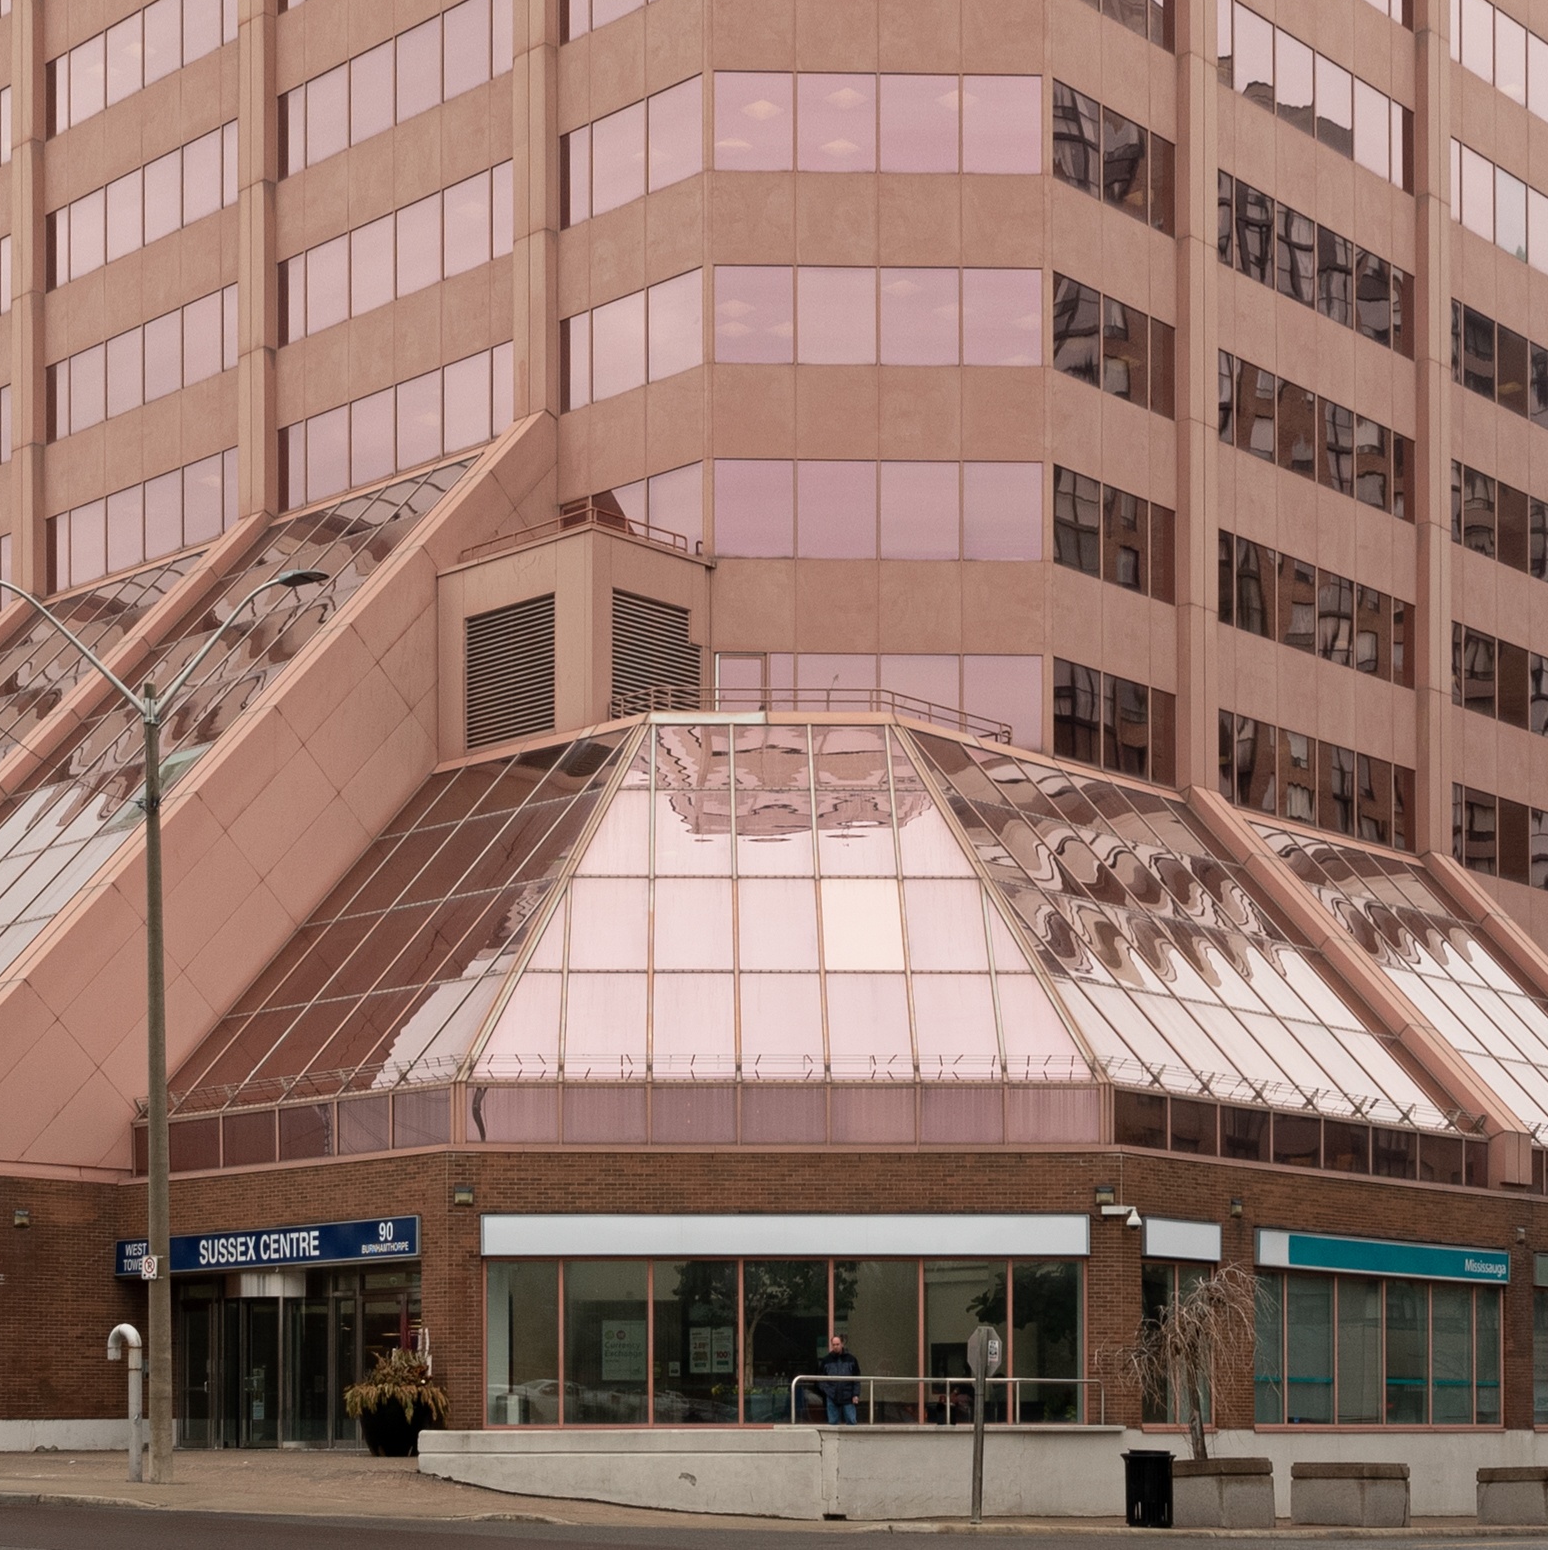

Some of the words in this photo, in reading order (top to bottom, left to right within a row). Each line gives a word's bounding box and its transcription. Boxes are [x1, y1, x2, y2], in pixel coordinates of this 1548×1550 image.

[378, 1221, 394, 1241] 90
[125, 1242, 147, 1256] WEST
[199, 1235, 256, 1265] SUSSEX
[260, 1230, 320, 1260] CENTRE
[361, 1241, 409, 1254] BURNHAMTHORPE
[123, 1258, 142, 1271] TOWE
[1464, 1258, 1507, 1278] Mississauga
